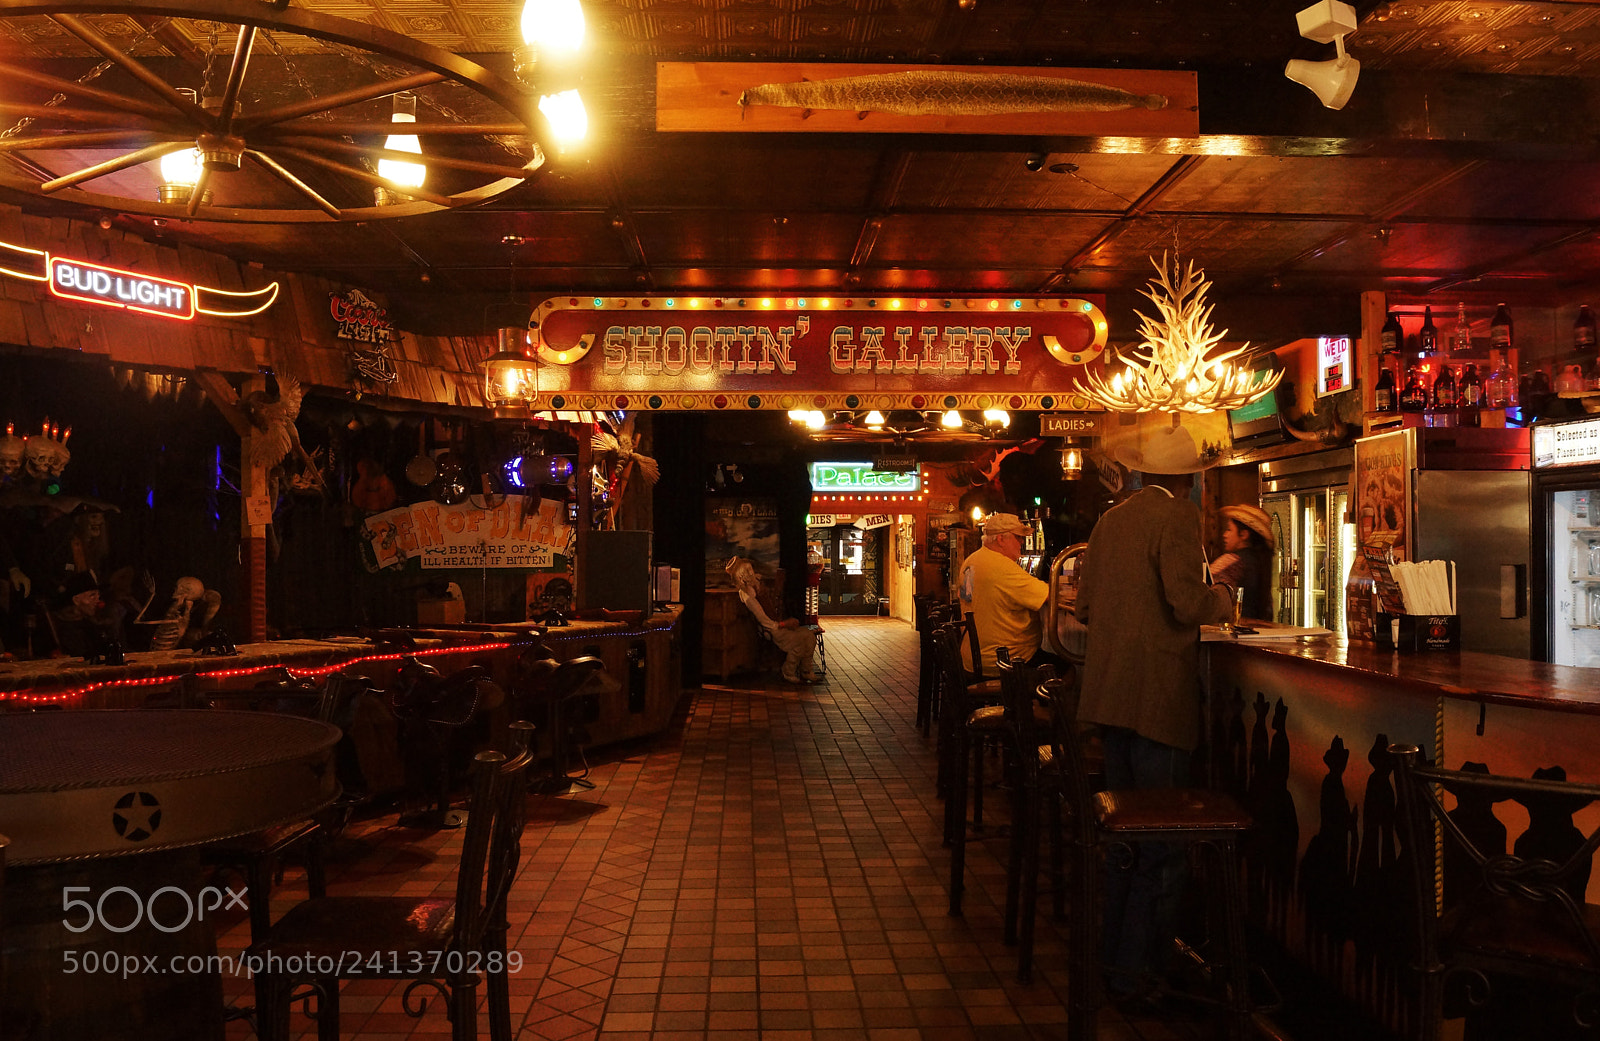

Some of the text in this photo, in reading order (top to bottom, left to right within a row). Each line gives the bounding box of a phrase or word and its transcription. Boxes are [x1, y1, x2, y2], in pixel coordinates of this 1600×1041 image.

[56, 264, 186, 310] BUD LIGHT
[602, 315, 1031, 376] SHOOTIN' GALLERY
[1048, 419, 1086, 431] LADIES
[818, 466, 912, 487] Palace
[446, 510, 485, 535] OF
[866, 514, 890, 527] MEN
[449, 545, 528, 555] BEWARE OF
[423, 557, 441, 567] ILL
[443, 556, 487, 567] HEALTH
[490, 556, 503, 566] IF
